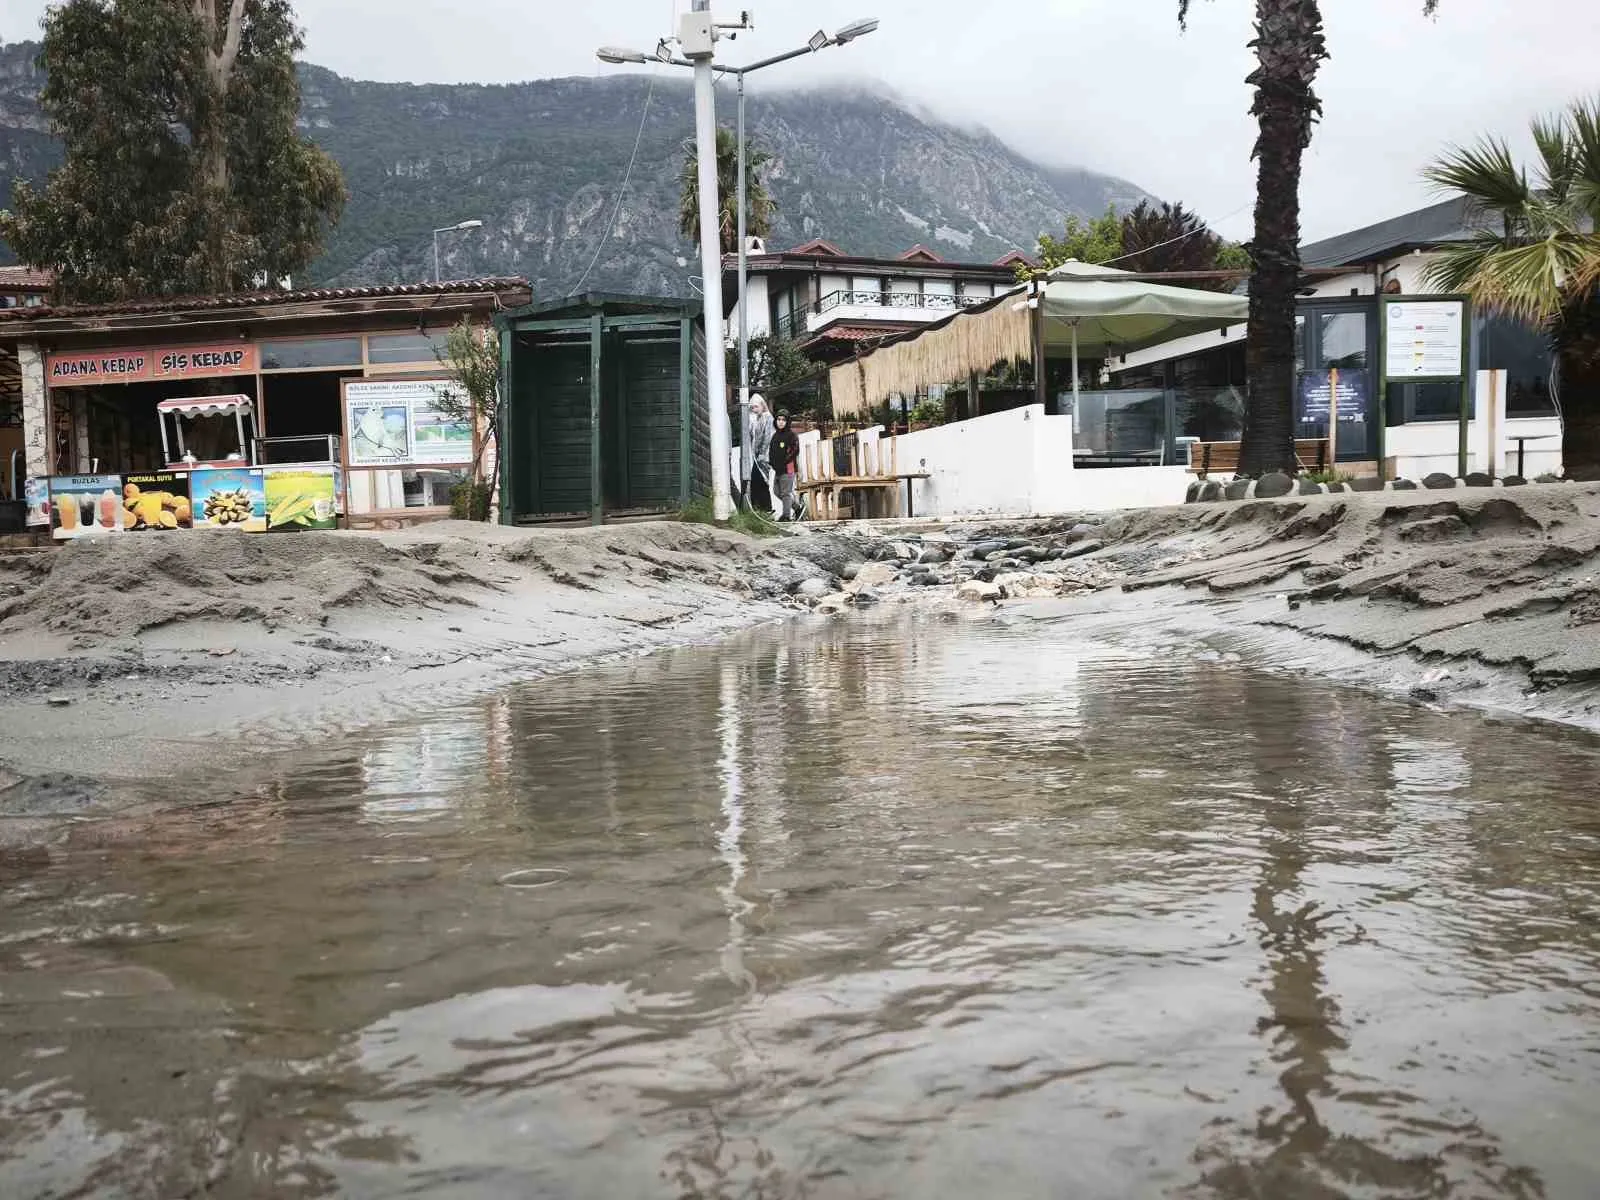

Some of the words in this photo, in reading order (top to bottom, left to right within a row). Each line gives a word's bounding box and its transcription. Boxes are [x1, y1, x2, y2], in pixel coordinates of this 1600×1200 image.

[53, 360, 97, 377] ADANA
[101, 357, 144, 374] KEBAP
[191, 351, 243, 368] KEBAP
[127, 475, 156, 483] PORTAKAL
